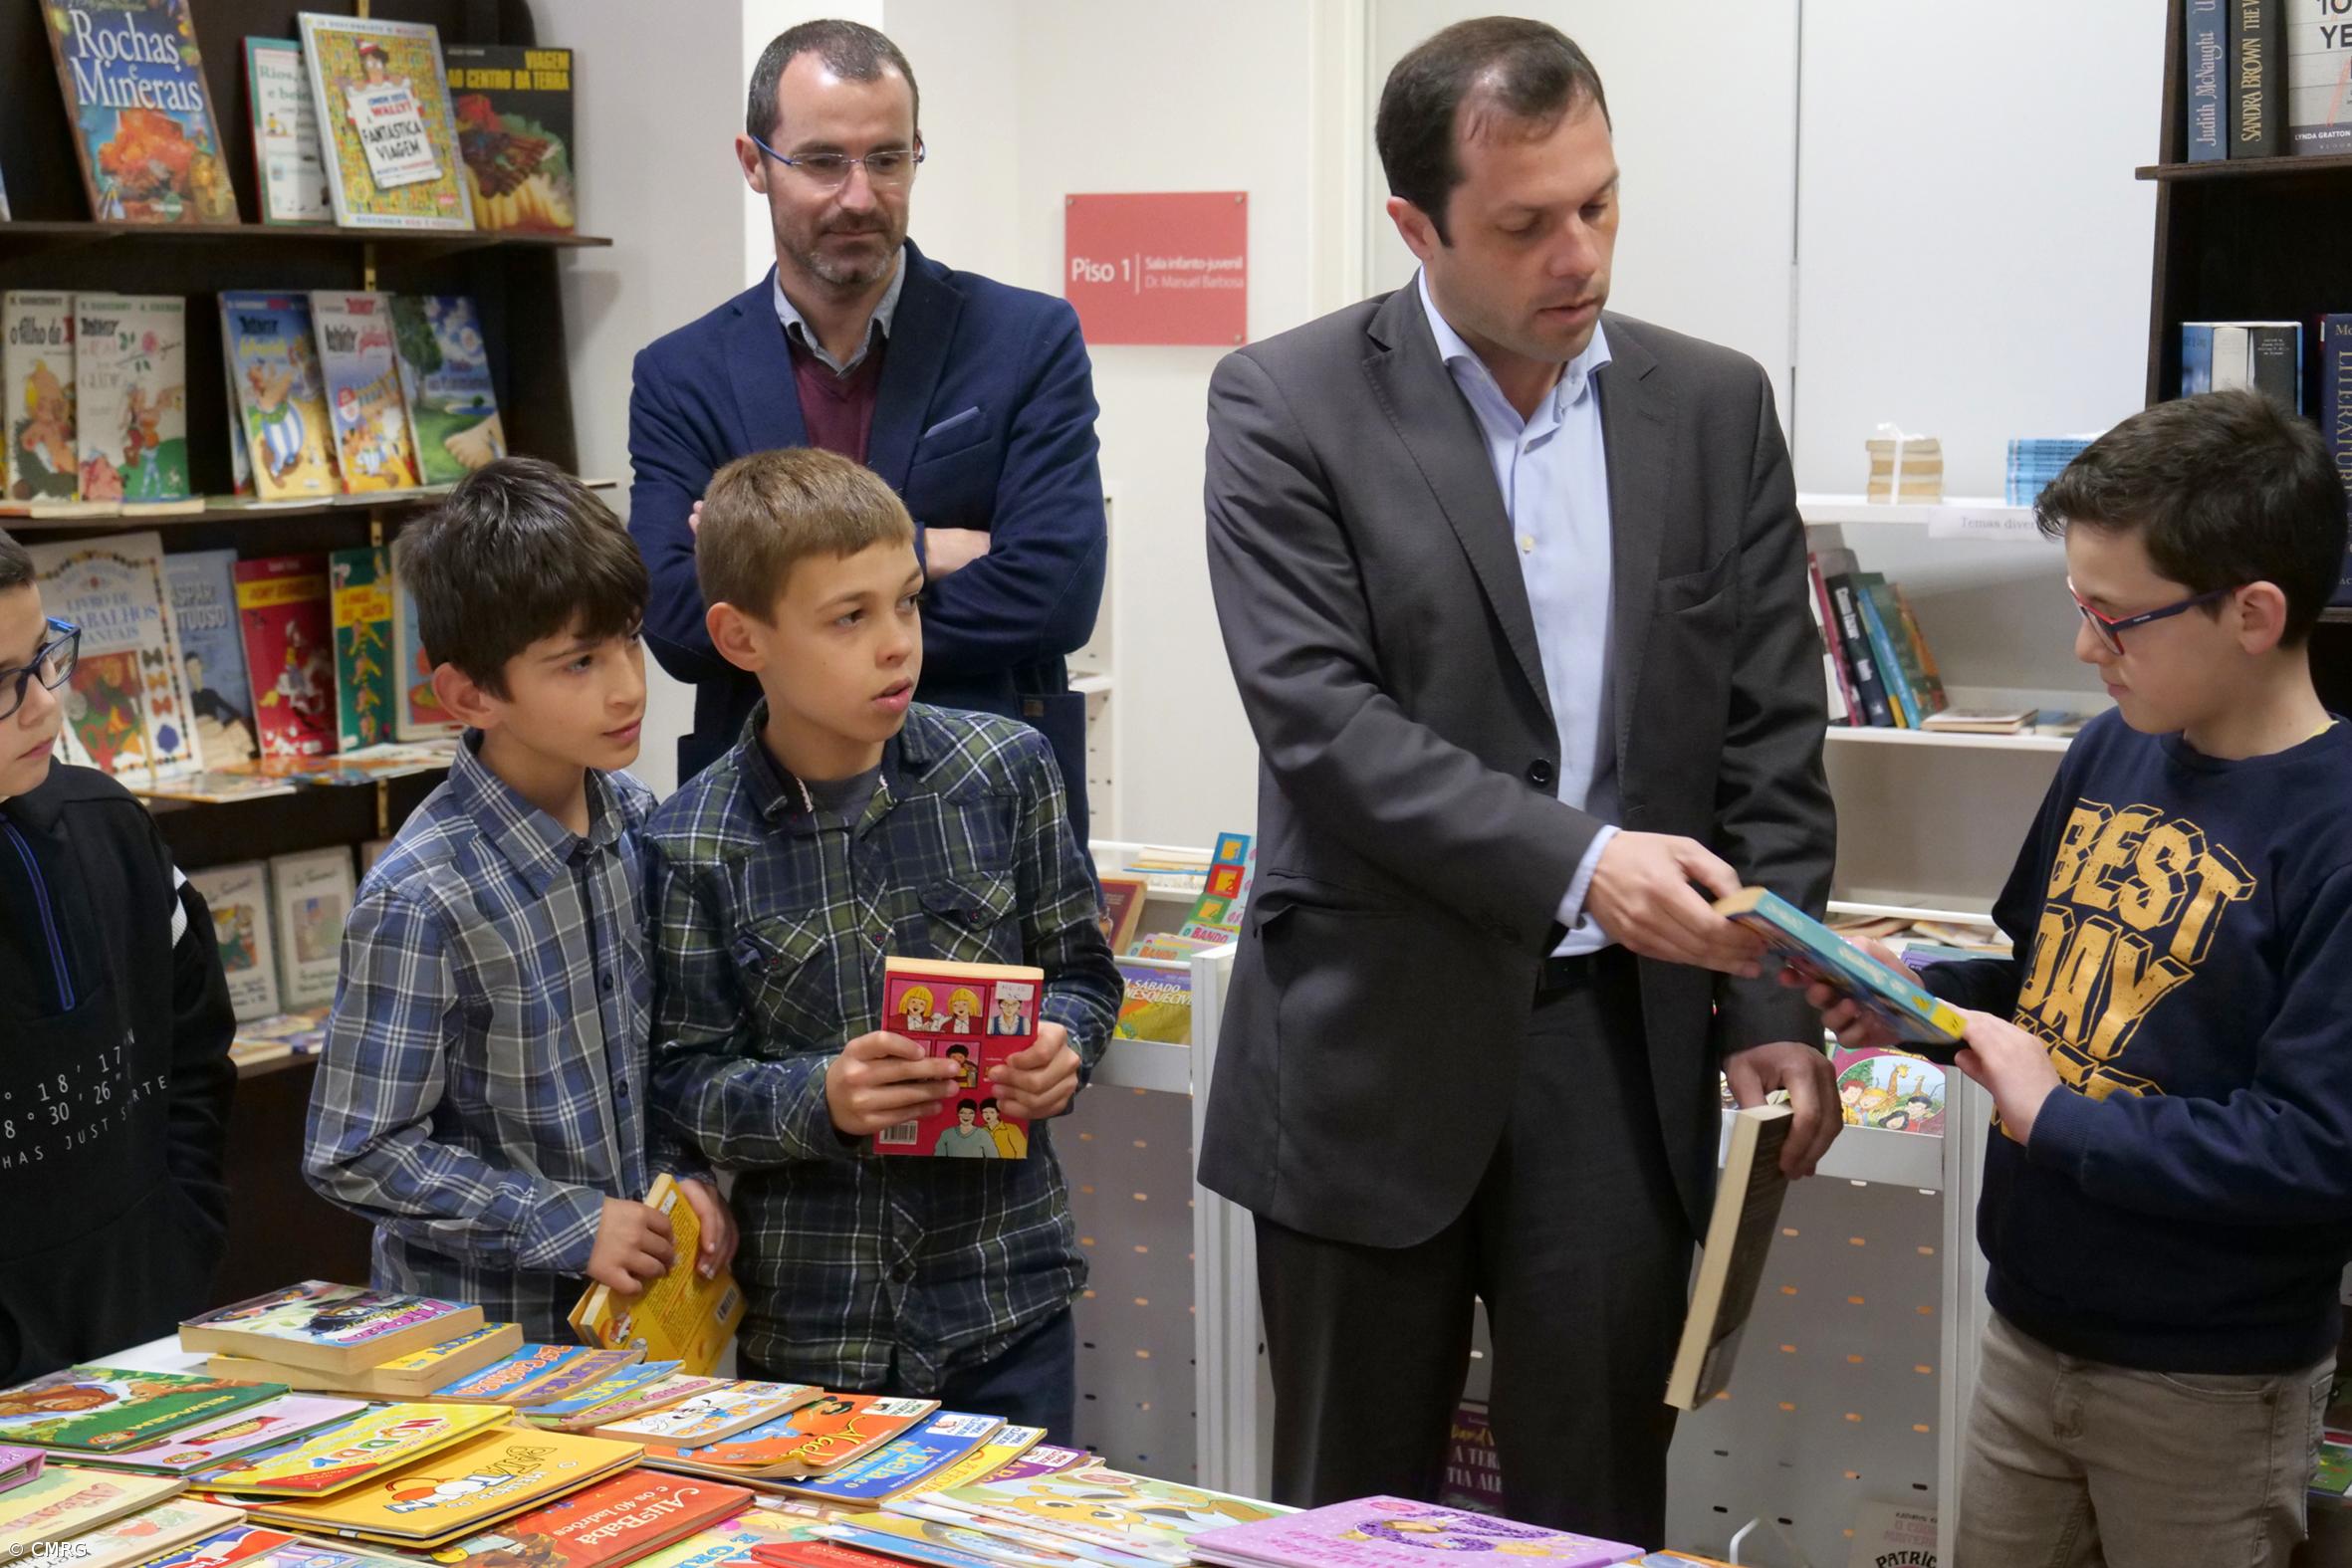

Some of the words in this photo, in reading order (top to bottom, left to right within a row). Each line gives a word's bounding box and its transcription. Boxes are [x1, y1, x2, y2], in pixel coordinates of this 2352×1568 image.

[2243, 8, 2259, 31] THE
[69, 9, 181, 73] Rochas
[525, 50, 570, 71] VIAGEM
[2195, 31, 2223, 100] McNaught
[2241, 38, 2262, 89] BROWN
[70, 57, 204, 112] Minerais
[465, 69, 512, 90] CENTRO
[514, 70, 532, 90] DA
[534, 71, 570, 91] TERRA
[2196, 103, 2217, 147] Judith
[2241, 91, 2262, 142] SANDRA
[2294, 132, 2318, 141] LYNDA
[2318, 130, 2351, 139] GRATTON
[1071, 258, 1115, 283] Piso
[1121, 258, 1130, 282] 1
[1145, 256, 1167, 271] Sala
[1162, 275, 1199, 288] Manuel
[2046, 797, 2257, 967] BEST
[1134, 979, 1181, 994] SÁBADO
[2016, 902, 2196, 1062] DAY
[2, 1146, 44, 1170] HAS
[66, 1117, 109, 1150] JUST
[613, 1500, 637, 1512] 40
[634, 1490, 656, 1501] os
[553, 1508, 617, 1537] ladrões
